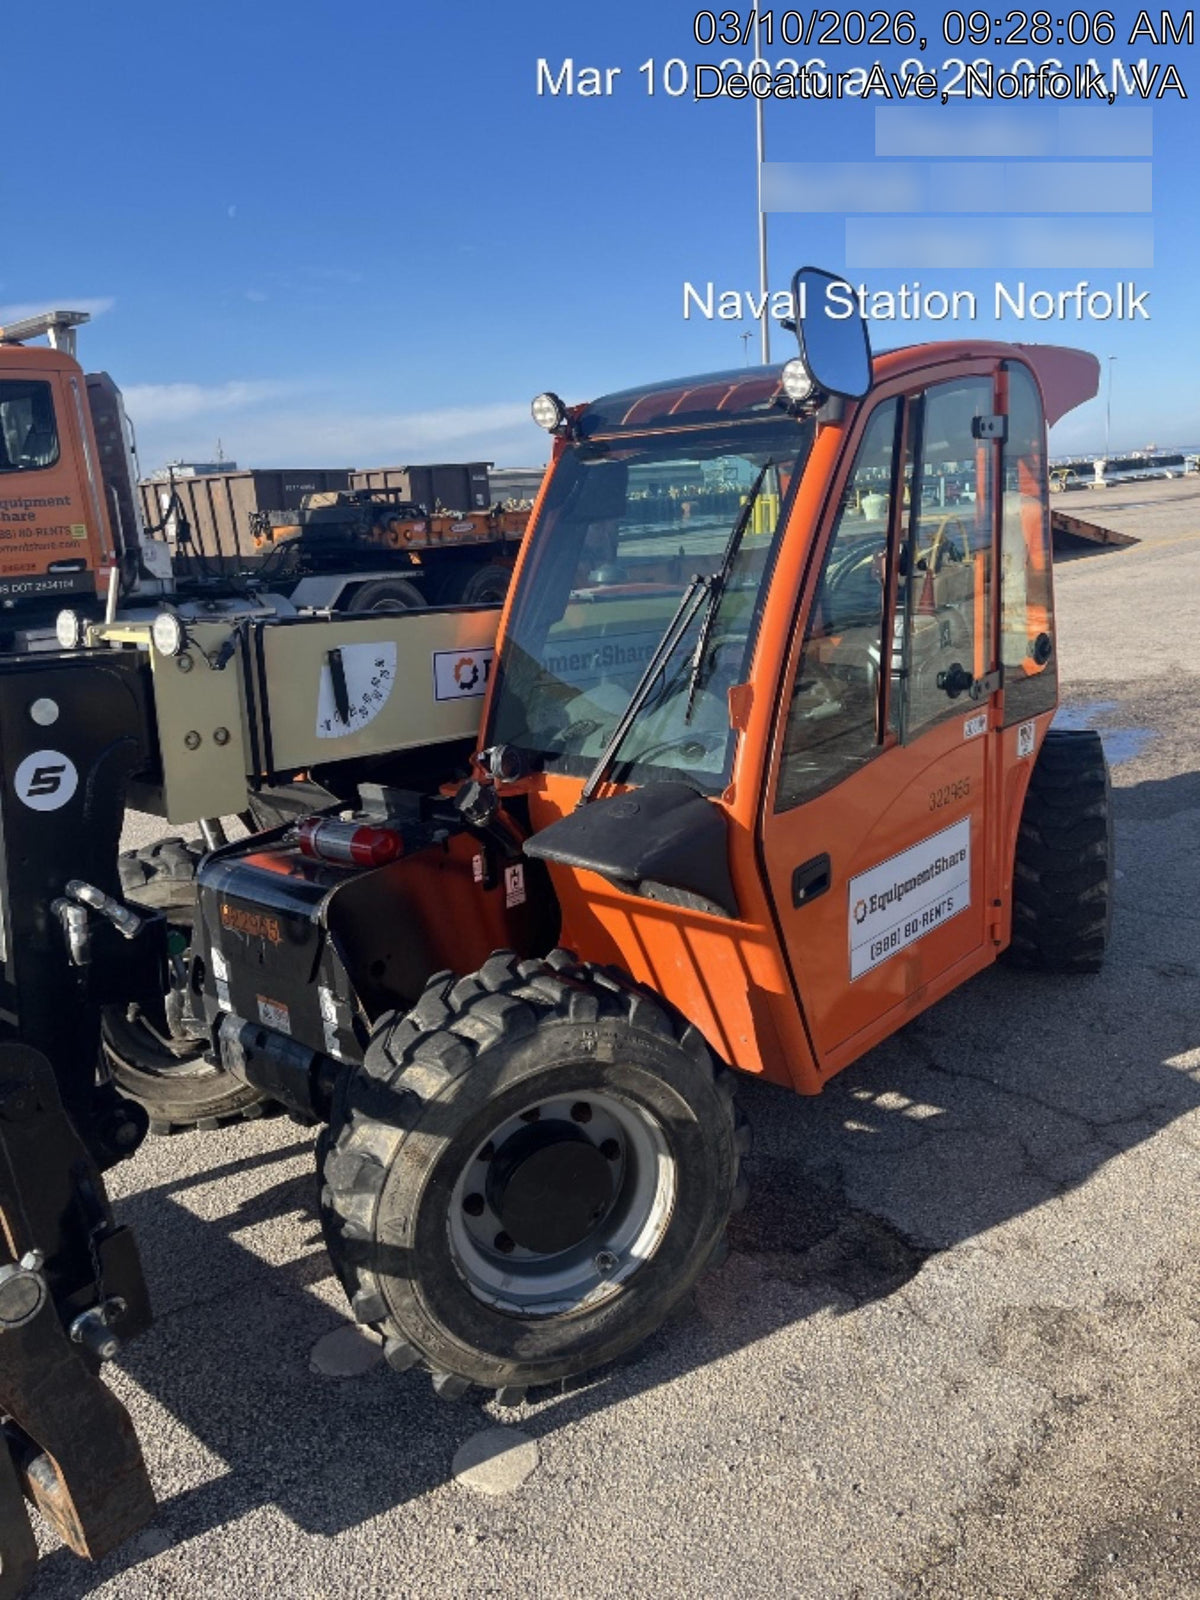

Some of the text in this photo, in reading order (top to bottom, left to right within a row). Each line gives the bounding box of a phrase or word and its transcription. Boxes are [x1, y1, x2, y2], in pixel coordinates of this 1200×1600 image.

[0, 496, 71, 510] quipment
[1, 511, 36, 521] hare
[0, 541, 81, 553] mentshare.com
[11, 582, 33, 593] DOT
[868, 848, 966, 915] EquipmentShare
